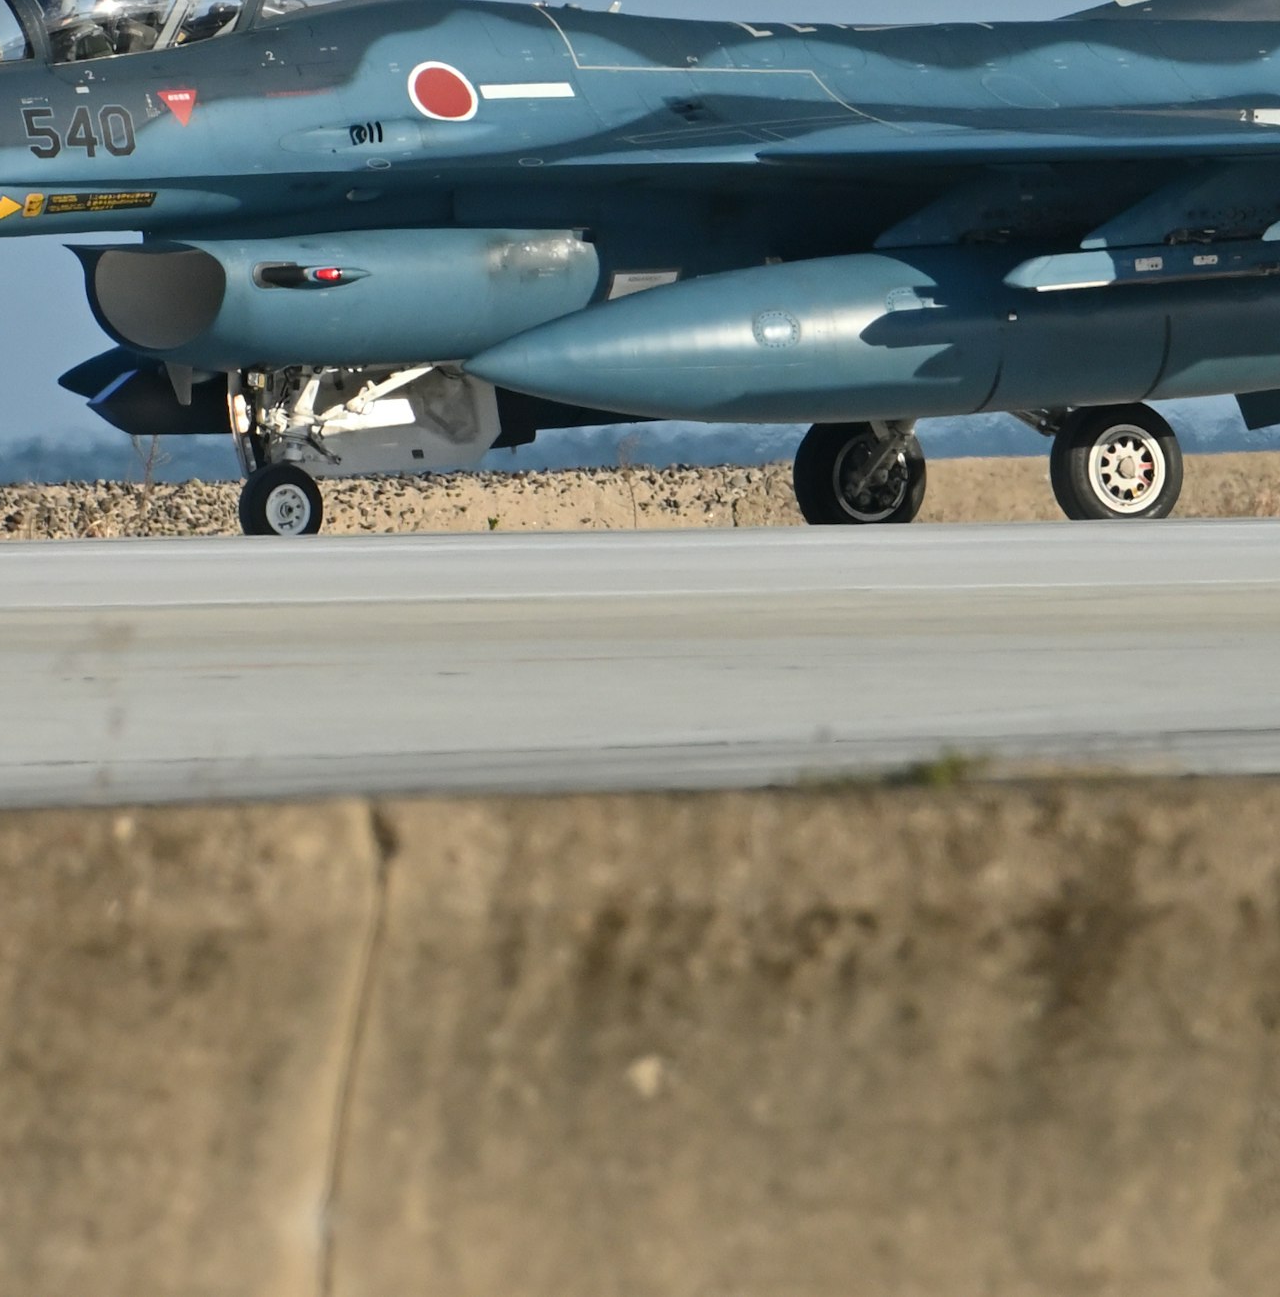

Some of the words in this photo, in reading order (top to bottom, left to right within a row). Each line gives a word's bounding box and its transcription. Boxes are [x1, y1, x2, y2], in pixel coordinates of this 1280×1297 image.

[265, 50, 275, 60] 2
[84, 69, 94, 79] 2
[1240, 109, 1247, 121] 2
[20, 104, 136, 159] 540
